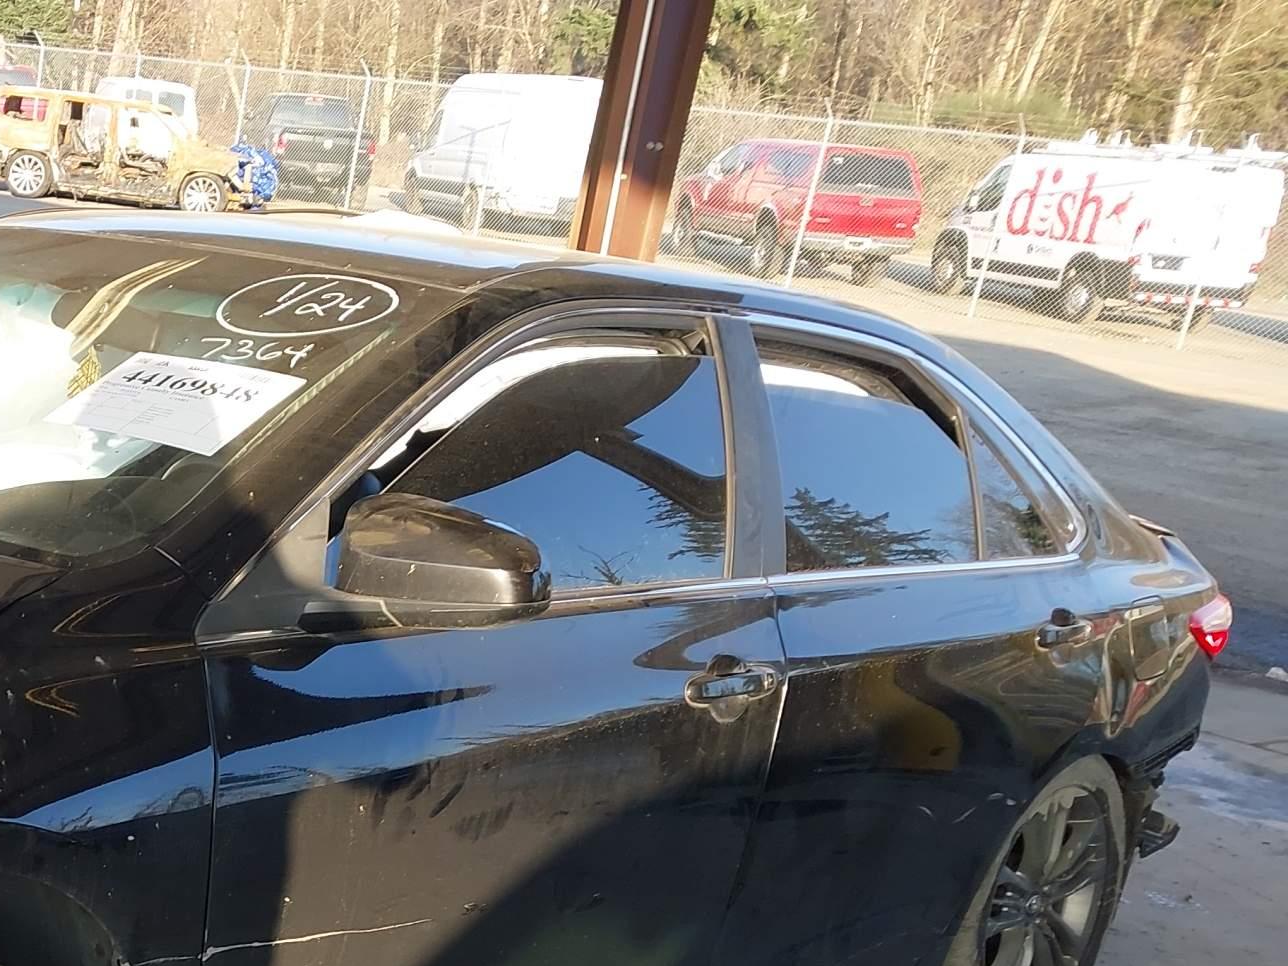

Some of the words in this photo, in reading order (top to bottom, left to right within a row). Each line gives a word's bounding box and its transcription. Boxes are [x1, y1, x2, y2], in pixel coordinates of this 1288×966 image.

[1006, 167, 1103, 244] dish
[258, 280, 372, 322] 1/24
[200, 337, 315, 369] 7364
[122, 369, 259, 402] 44169848
